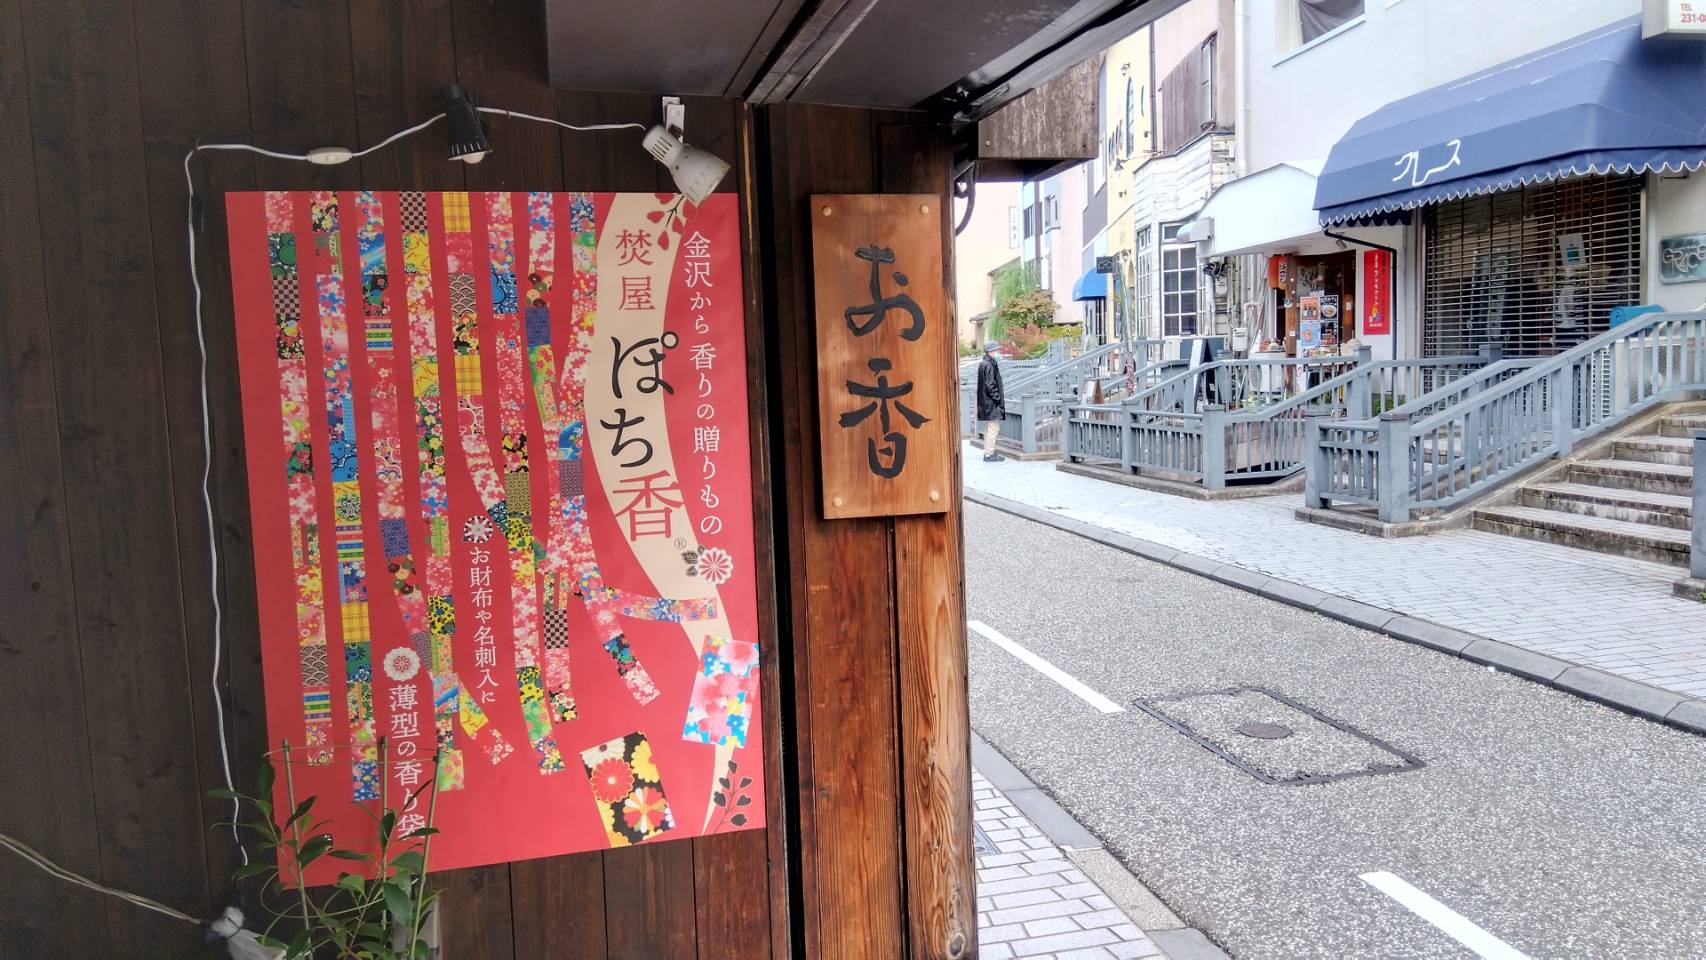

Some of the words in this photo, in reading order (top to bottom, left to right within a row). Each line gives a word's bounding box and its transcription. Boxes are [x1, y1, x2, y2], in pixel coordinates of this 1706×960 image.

[1680, 3, 1693, 11] TEL
[683, 231, 723, 535] 金沢から香りの贈りもの
[838, 243, 932, 479] お香
[469, 546, 499, 703] お財布や名刺入に
[388, 684, 426, 841] 薄型の香り袋
